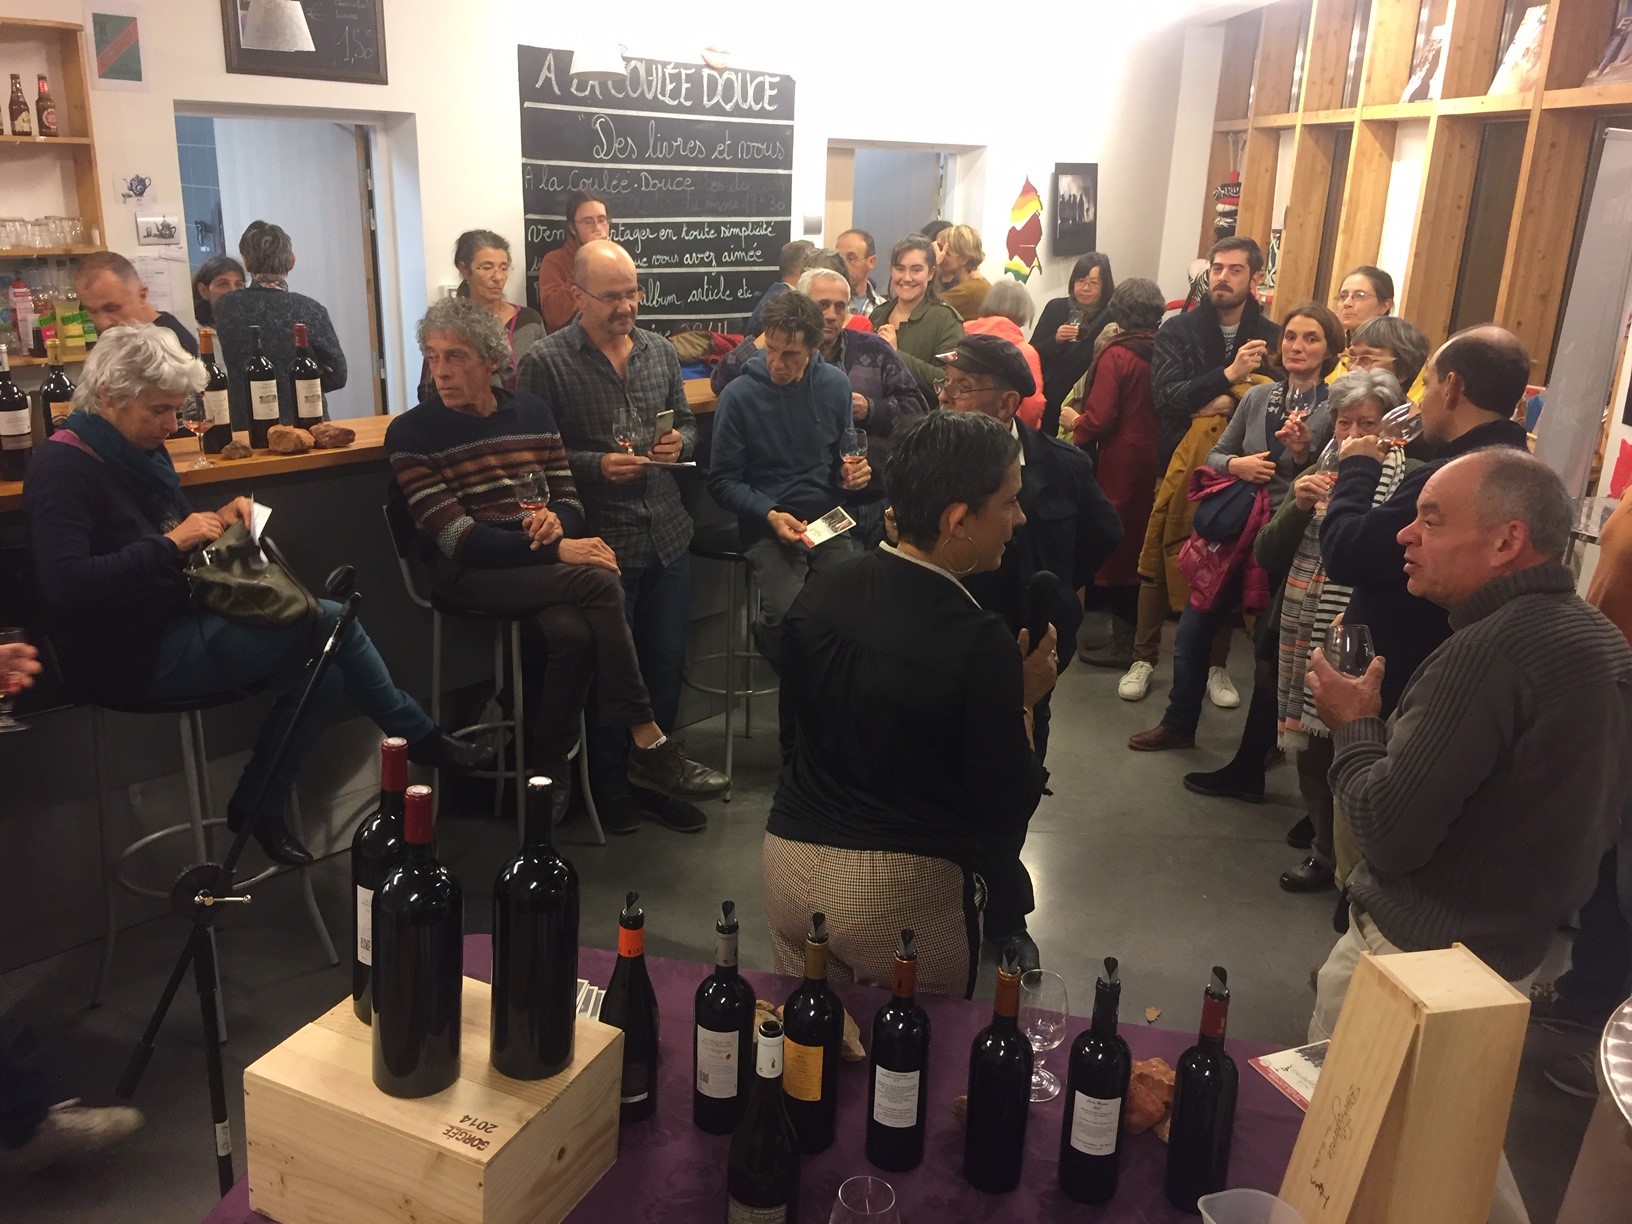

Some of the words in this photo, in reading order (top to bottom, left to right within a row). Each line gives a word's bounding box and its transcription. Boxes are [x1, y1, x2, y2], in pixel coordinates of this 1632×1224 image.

[535, 50, 561, 95] A
[701, 67, 781, 112] DOUCE
[645, 119, 706, 158] livres
[711, 129, 734, 160] et
[525, 165, 534, 191] A
[538, 163, 565, 192] la
[639, 171, 695, 191] Douce
[528, 224, 566, 243] Ven
[609, 222, 658, 254] rtager
[659, 228, 678, 242] en
[681, 222, 718, 240] toute
[720, 219, 777, 249] simplicité
[651, 253, 680, 267] vous
[683, 250, 718, 276] avez
[721, 242, 765, 264] aimée
[687, 275, 734, 303] article
[459, 1114, 499, 1134] 2014
